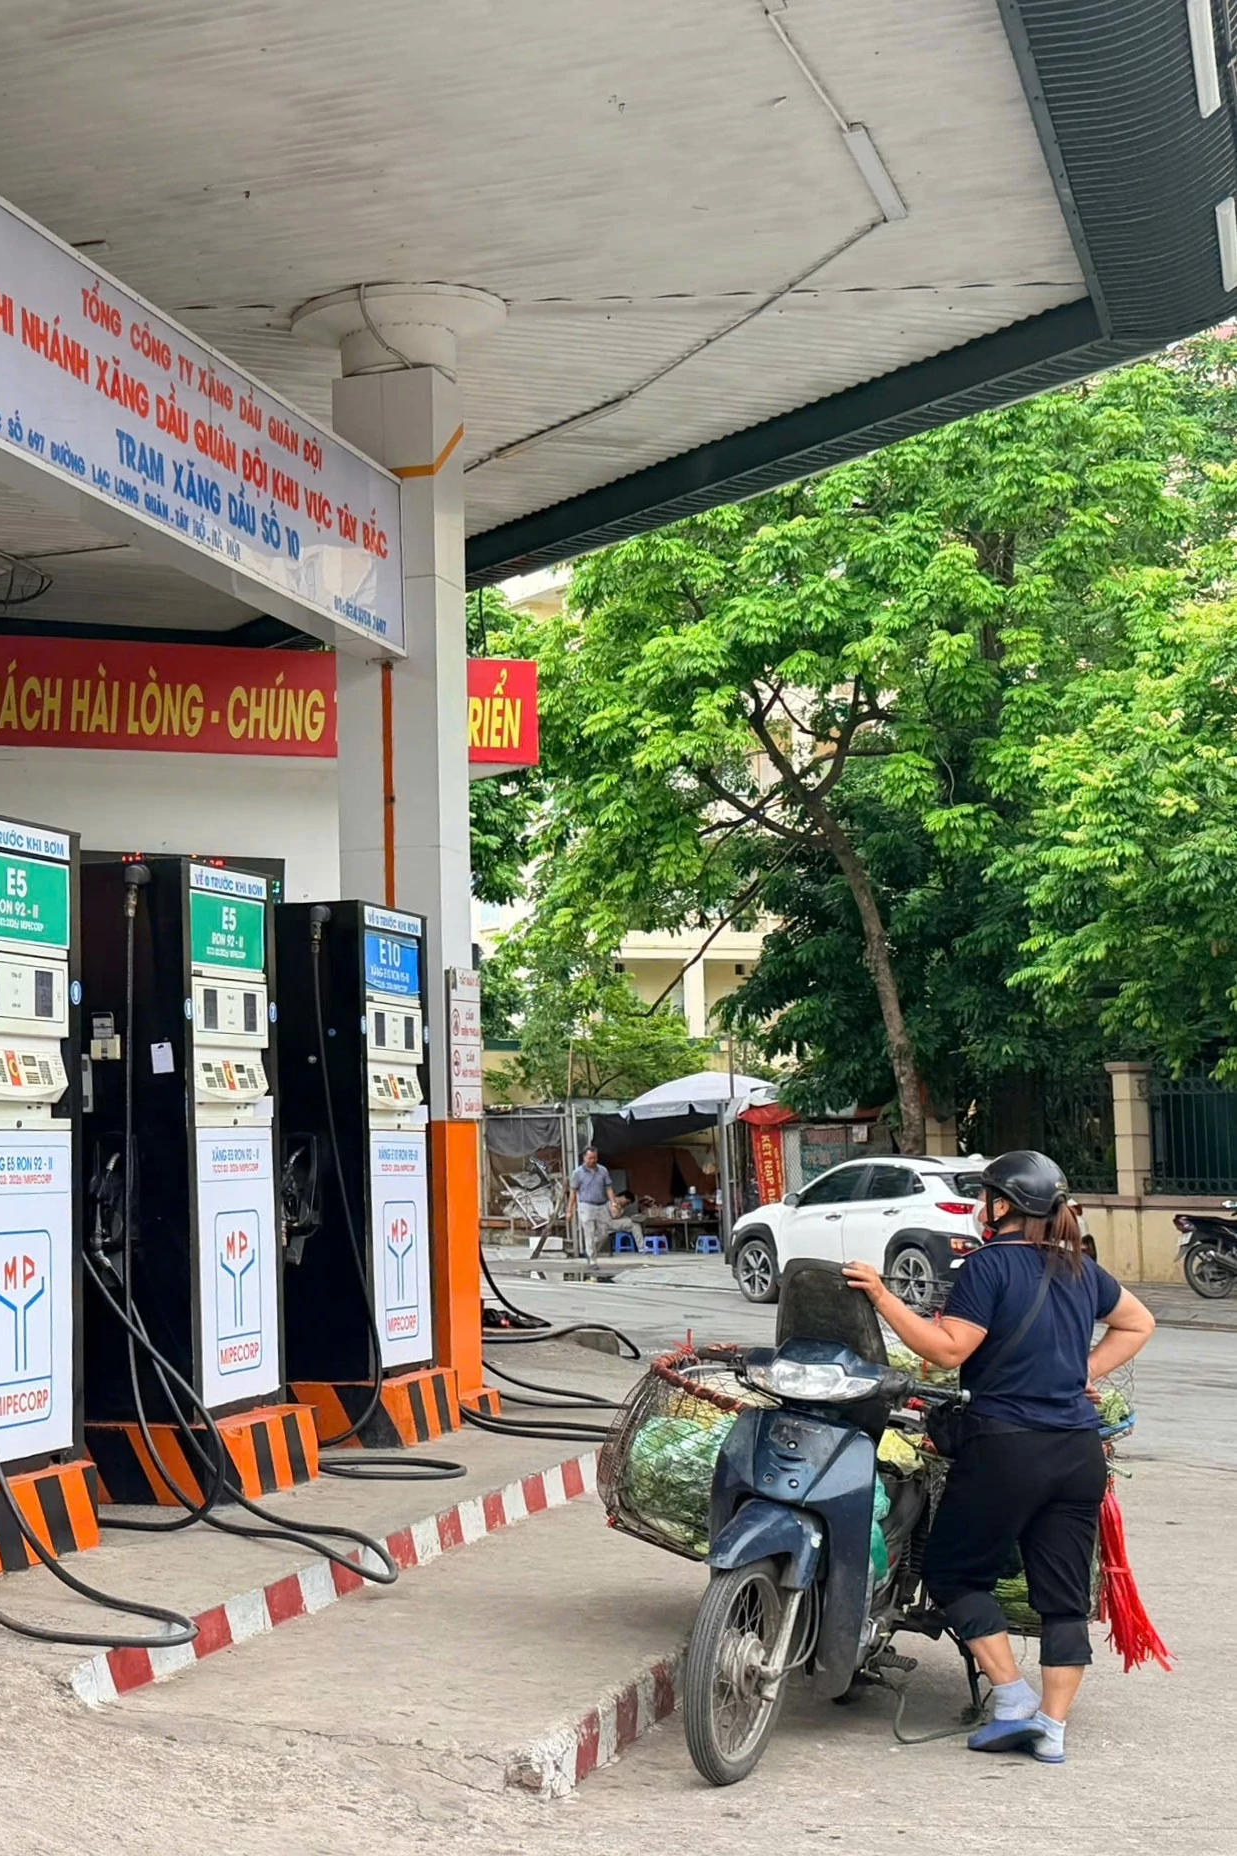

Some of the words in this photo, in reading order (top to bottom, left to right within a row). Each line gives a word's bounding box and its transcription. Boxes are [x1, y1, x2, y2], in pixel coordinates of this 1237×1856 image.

[81, 280, 122, 337] TỔNG
[130, 321, 172, 371] CÔNG
[178, 354, 194, 386] TY
[198, 367, 233, 412] XĂNG
[239, 386, 262, 431] DẦU
[268, 416, 299, 456] QUÂN
[303, 437, 323, 474] ĐỘI
[21, 315, 90, 385] NHÁNH
[96, 355, 149, 419] XĂNG
[156, 381, 189, 443] DẦU
[194, 419, 236, 475] QUÂN
[242, 447, 268, 498] ĐỘI
[272, 468, 299, 511] KHU
[304, 487, 332, 533] VỰC
[337, 503, 357, 544] TÂY
[362, 508, 388, 560] BẮC
[8, 410, 24, 442] SỐ
[28, 429, 45, 454] 697
[51, 441, 86, 475] ĐƯỜNG
[92, 464, 111, 493] LẠC
[115, 476, 139, 504] LONG
[144, 493, 169, 522] QUÂN
[116, 428, 164, 487] TRẠM
[173, 459, 221, 516] XĂNG
[228, 482, 257, 537] DẦU
[261, 500, 282, 550] SỐ
[285, 526, 301, 561] 10
[70, 663, 119, 733] HÀI
[127, 665, 204, 737] LÒNG
[227, 671, 325, 742] CHÚNG
[26, 836, 42, 852] KHI
[44, 840, 65, 857] BƠM
[7, 867, 27, 898] E5
[14, 901, 26, 917] 92
[222, 906, 237, 931] E5
[212, 932, 226, 946] RON
[227, 934, 235, 948] 92
[379, 938, 401, 968] E10
[7, 1157, 15, 1171] E5
[16, 1157, 32, 1170] RON
[33, 1157, 42, 1170] 92
[391, 1218, 408, 1243] MP
[226, 1231, 248, 1260] MP
[4, 1255, 35, 1290] MP
[387, 1314, 417, 1332] MIPECORP
[220, 1342, 260, 1365] MIPECORP
